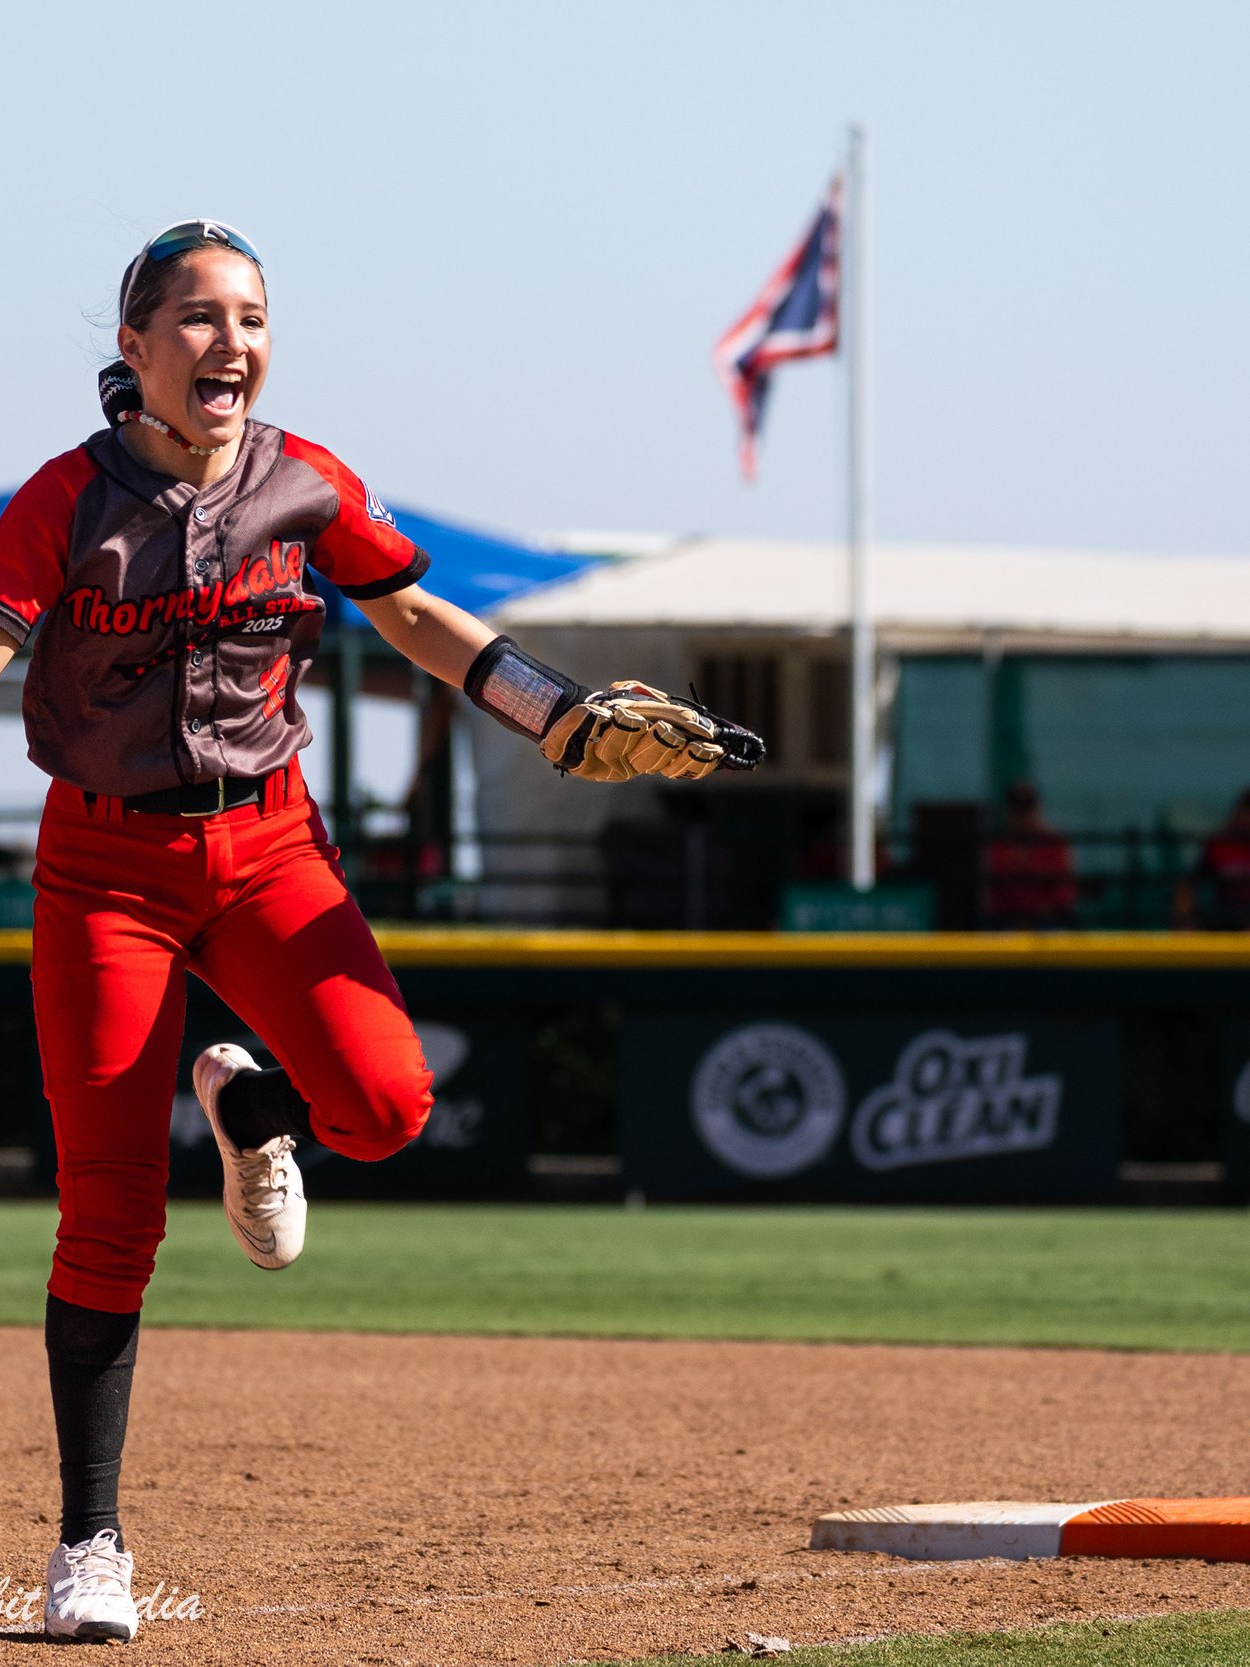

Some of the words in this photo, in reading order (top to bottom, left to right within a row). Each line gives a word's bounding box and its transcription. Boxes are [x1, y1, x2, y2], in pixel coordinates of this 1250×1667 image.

[64, 538, 303, 635] Thornydale
[218, 606, 258, 628] ALL
[241, 614, 285, 633] 2025
